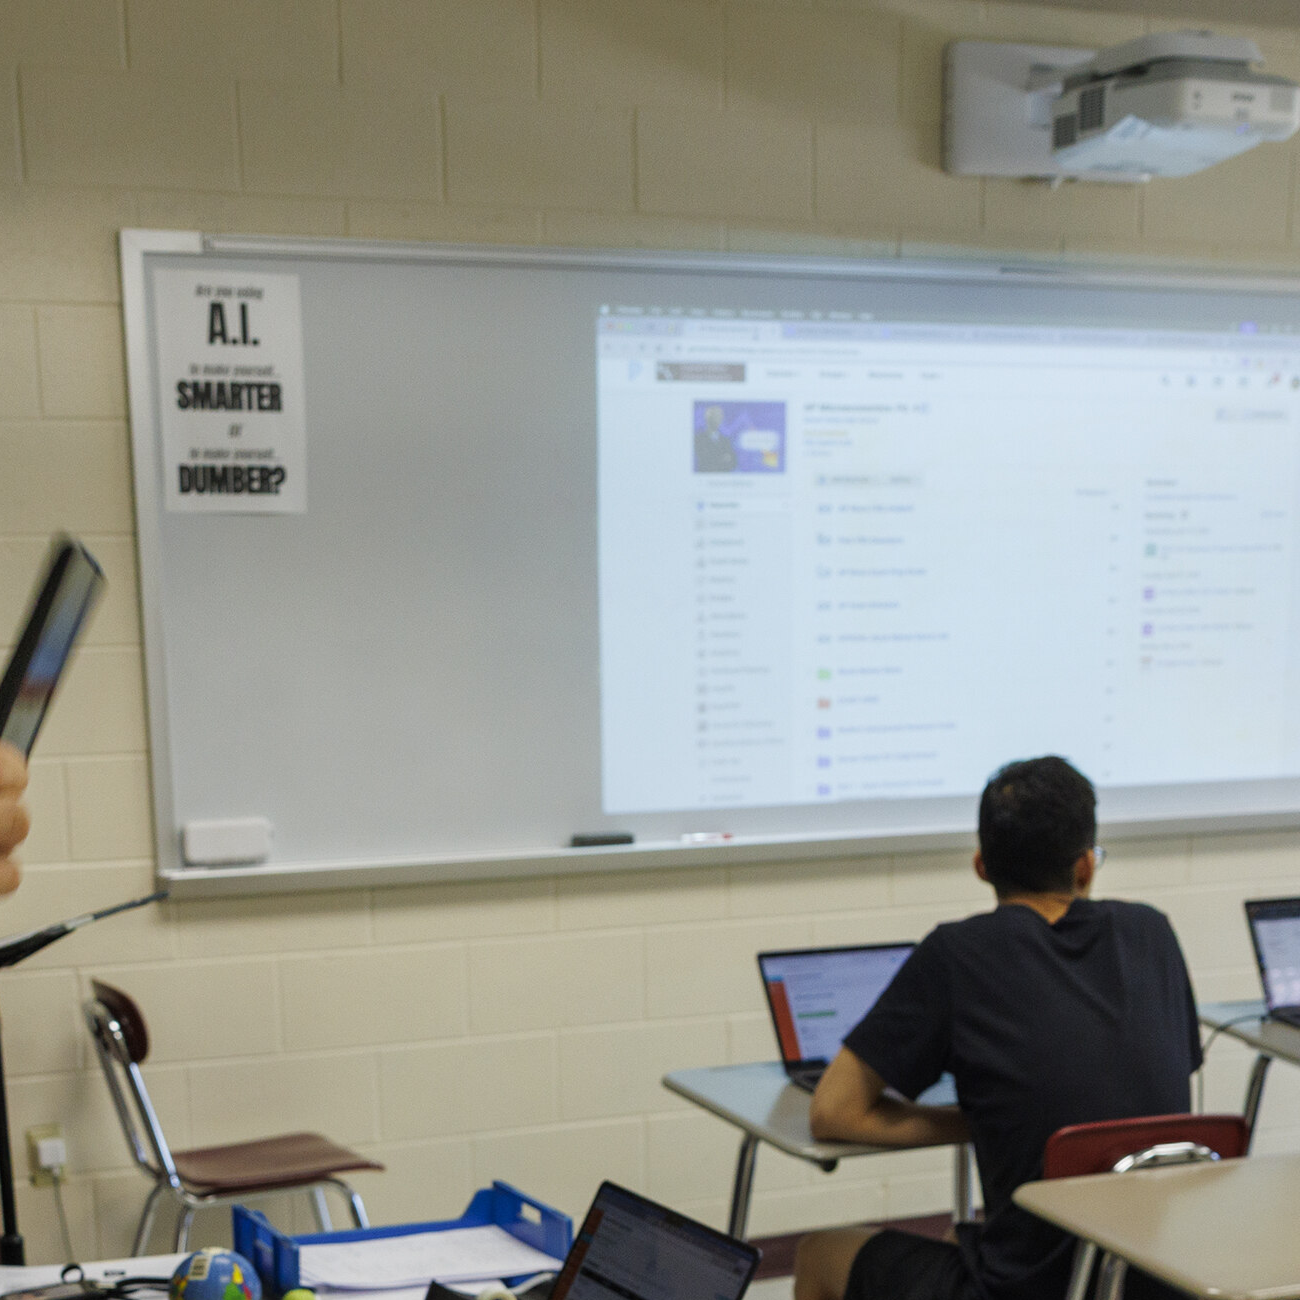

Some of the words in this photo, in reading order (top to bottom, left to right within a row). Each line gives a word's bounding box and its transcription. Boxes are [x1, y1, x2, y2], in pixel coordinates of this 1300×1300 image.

[208, 301, 260, 345] A.I.
[176, 382, 282, 411] SMARTER
[178, 464, 287, 495] DUMBER?
